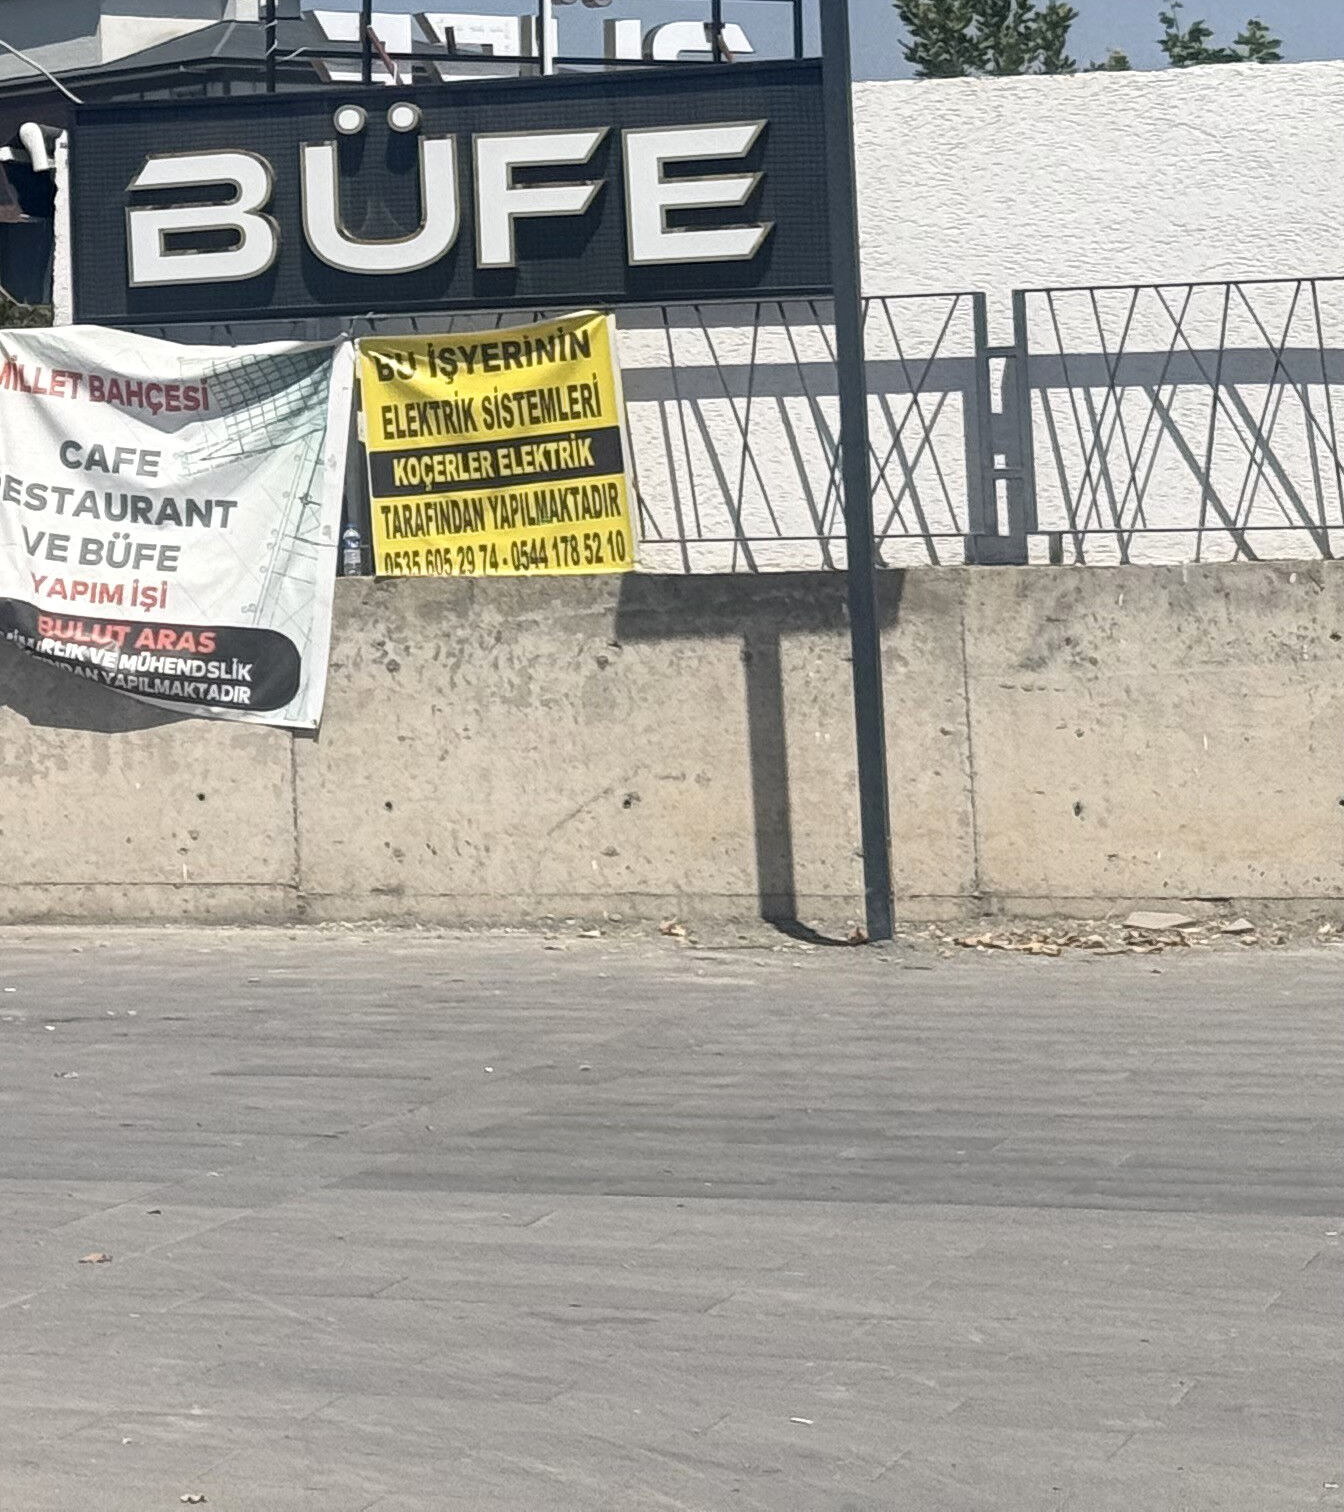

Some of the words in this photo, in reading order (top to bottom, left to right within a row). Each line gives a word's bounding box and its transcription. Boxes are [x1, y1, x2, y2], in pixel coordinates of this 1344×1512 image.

[126, 101, 775, 287] BÜFE
[427, 327, 591, 384] İŞYERİNİN
[88, 374, 210, 416] BAHÇESİ
[381, 391, 478, 440] ELEKTRİK
[481, 372, 602, 430] SİSTEMLERİ
[59, 439, 162, 478] CAFE
[393, 450, 495, 491] KOÇERLER
[497, 433, 595, 476] ELEKTRİK
[381, 497, 485, 539] TARAFINDAN
[486, 482, 621, 529] YAPILMAKTADIR
[21, 524, 71, 563] VE
[78, 531, 181, 572] BÜFE
[426, 548, 452, 576] 605
[457, 545, 475, 575] 29
[479, 542, 499, 575] 74
[511, 537, 548, 571] 0544
[552, 534, 580, 567] 178
[584, 532, 603, 565] 52
[607, 529, 625, 562] 10
[30, 571, 124, 606] YAPIM
[130, 578, 168, 612] İŞİ
[37, 615, 131, 647] BULUT
[134, 627, 217, 654] ARAS
[88, 646, 118, 671] VE
[102, 671, 251, 704] YAPILMAKTADIR
